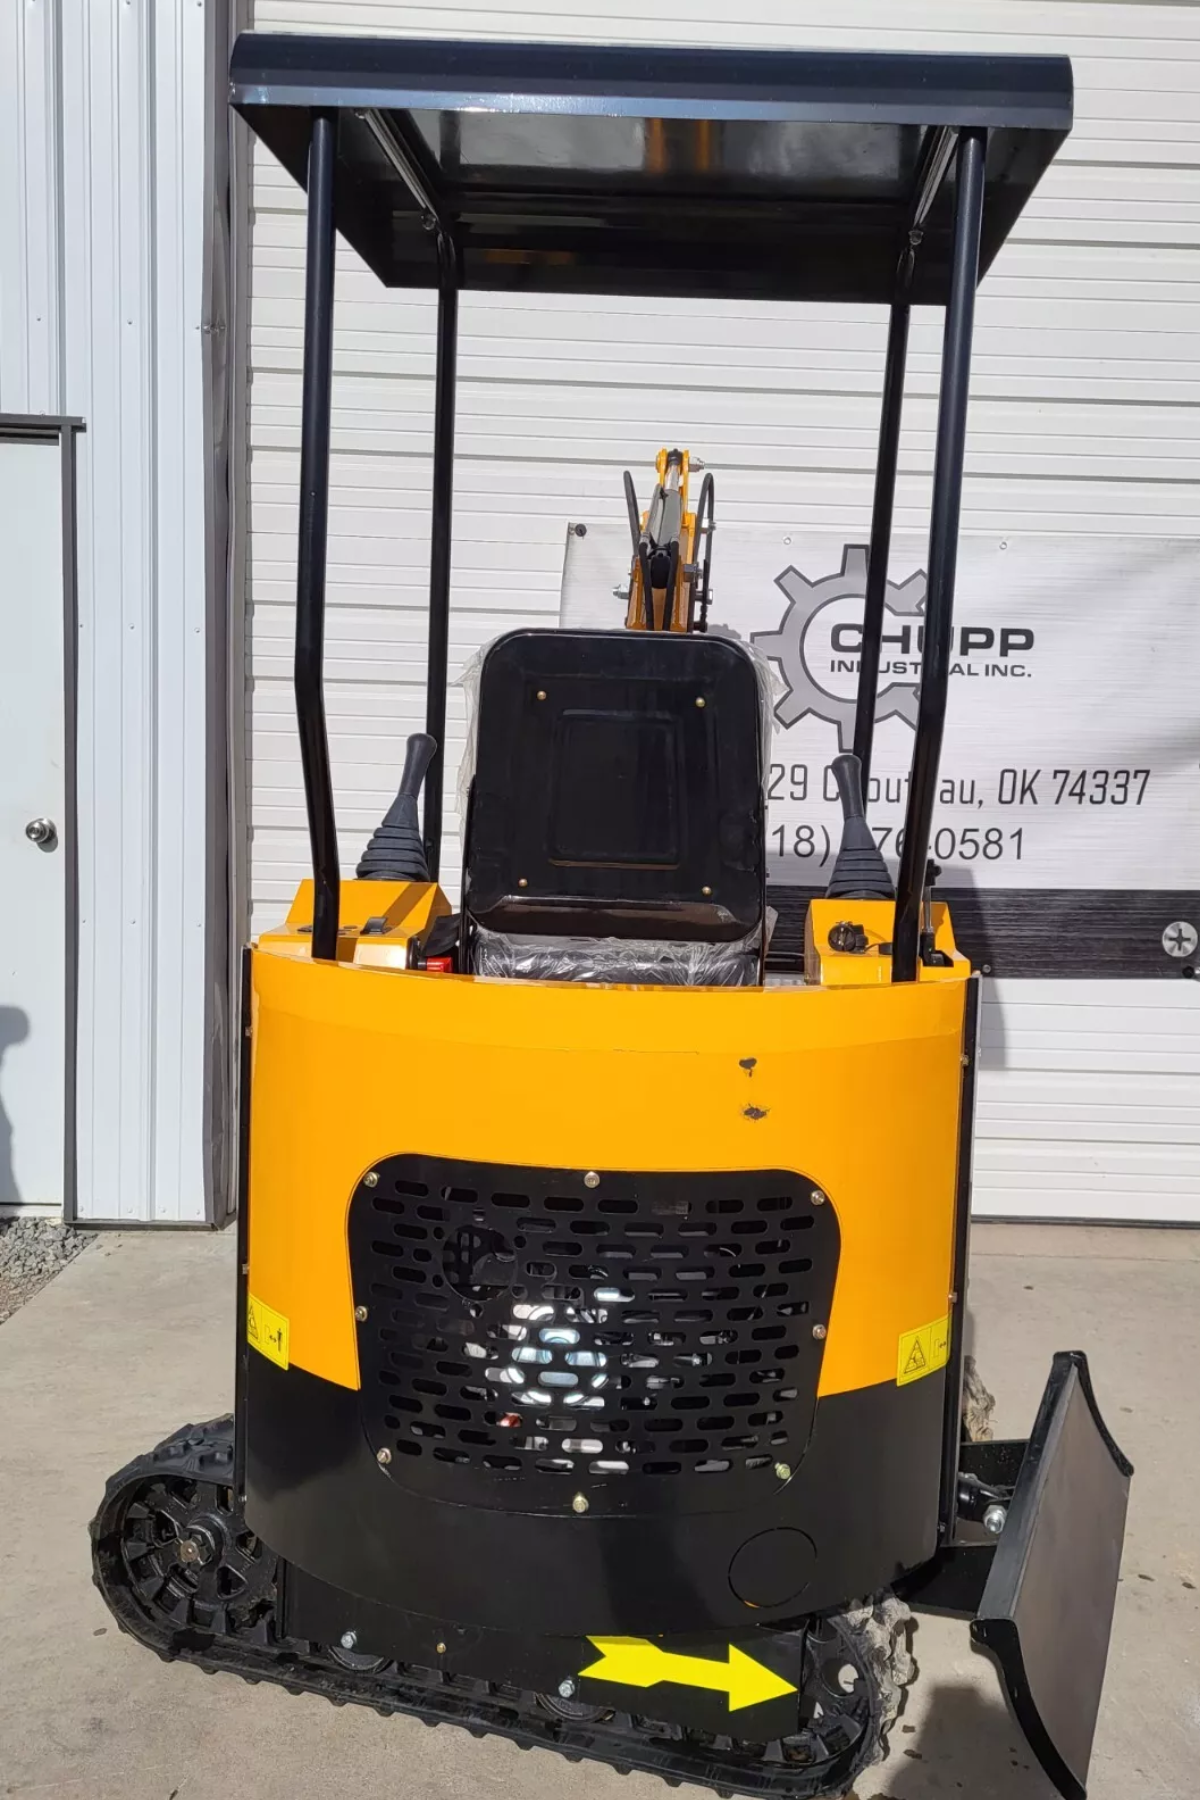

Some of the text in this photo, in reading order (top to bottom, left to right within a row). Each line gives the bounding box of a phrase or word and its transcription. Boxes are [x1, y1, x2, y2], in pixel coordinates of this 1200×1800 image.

[830, 623, 1035, 657] CHPP
[830, 660, 1032, 678] INUSTAL INC.
[998, 768, 1042, 805] OK
[1052, 769, 1151, 805] 74337
[771, 824, 831, 868] 18)
